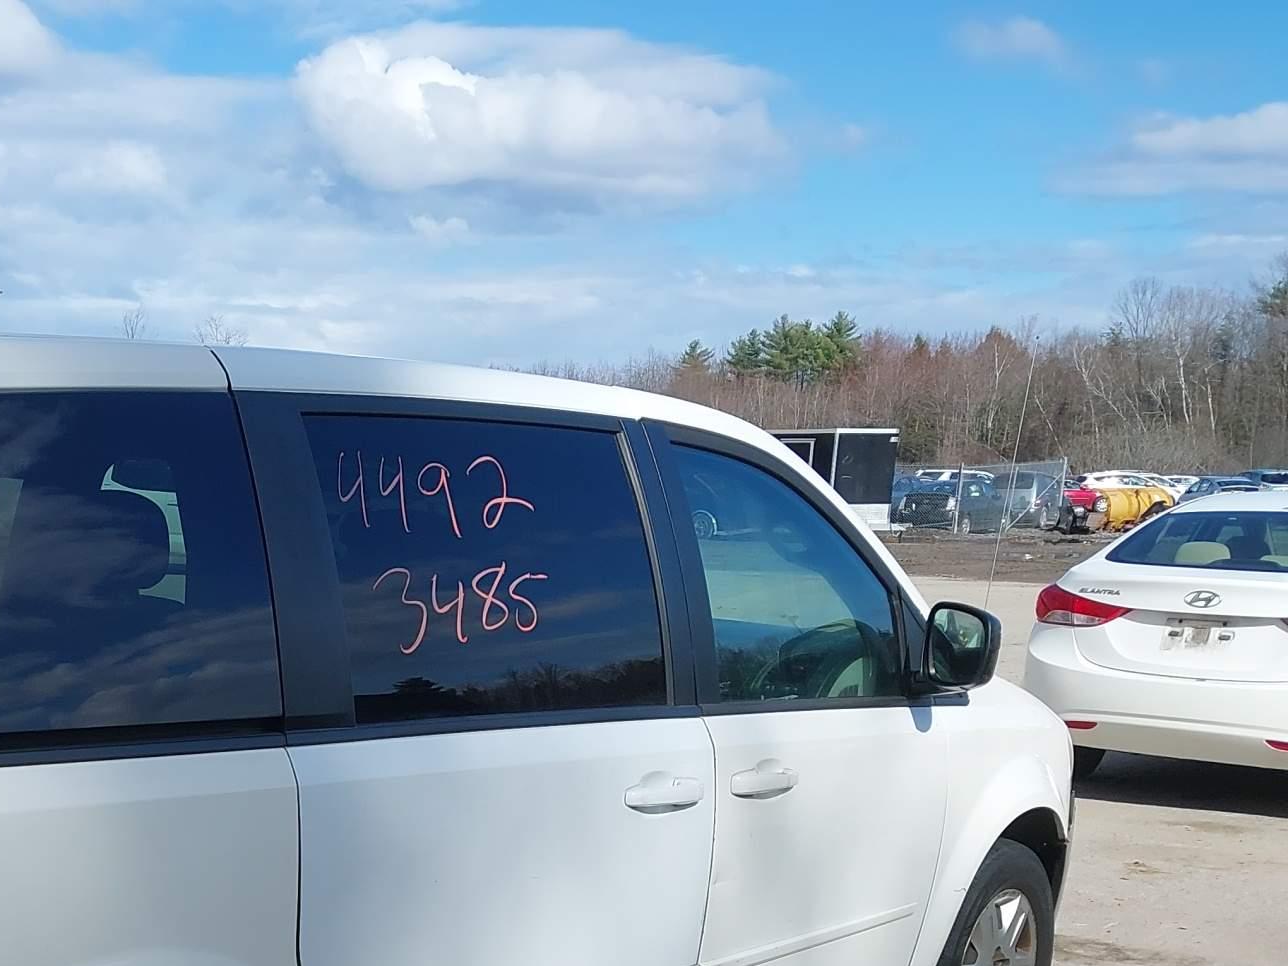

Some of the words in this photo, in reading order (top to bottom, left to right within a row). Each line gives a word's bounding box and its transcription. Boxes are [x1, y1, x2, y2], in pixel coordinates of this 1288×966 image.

[337, 450, 536, 538] 4492
[372, 560, 549, 655] 3485
[1078, 587, 1121, 596] ELANTRA
